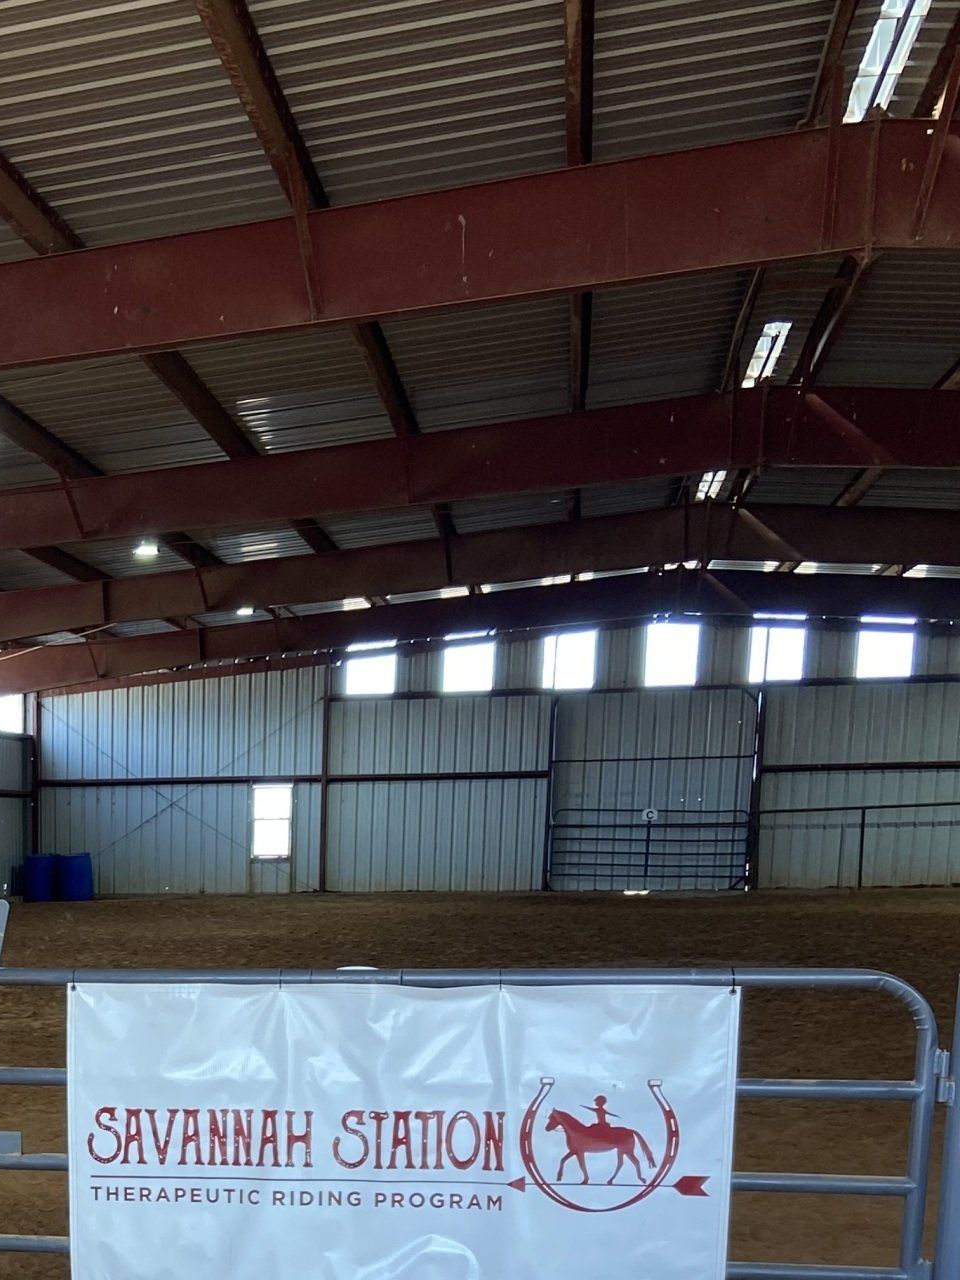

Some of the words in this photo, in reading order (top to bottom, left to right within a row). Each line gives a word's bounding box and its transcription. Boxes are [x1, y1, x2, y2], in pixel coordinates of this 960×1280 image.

[646, 810, 655, 820] C
[87, 1106, 314, 1168] SAVANNAH
[332, 1109, 506, 1172] STATION
[90, 1185, 260, 1205] THERAPEUTIC
[272, 1190, 362, 1207] RIDING
[374, 1192, 503, 1211] PROGRAM
